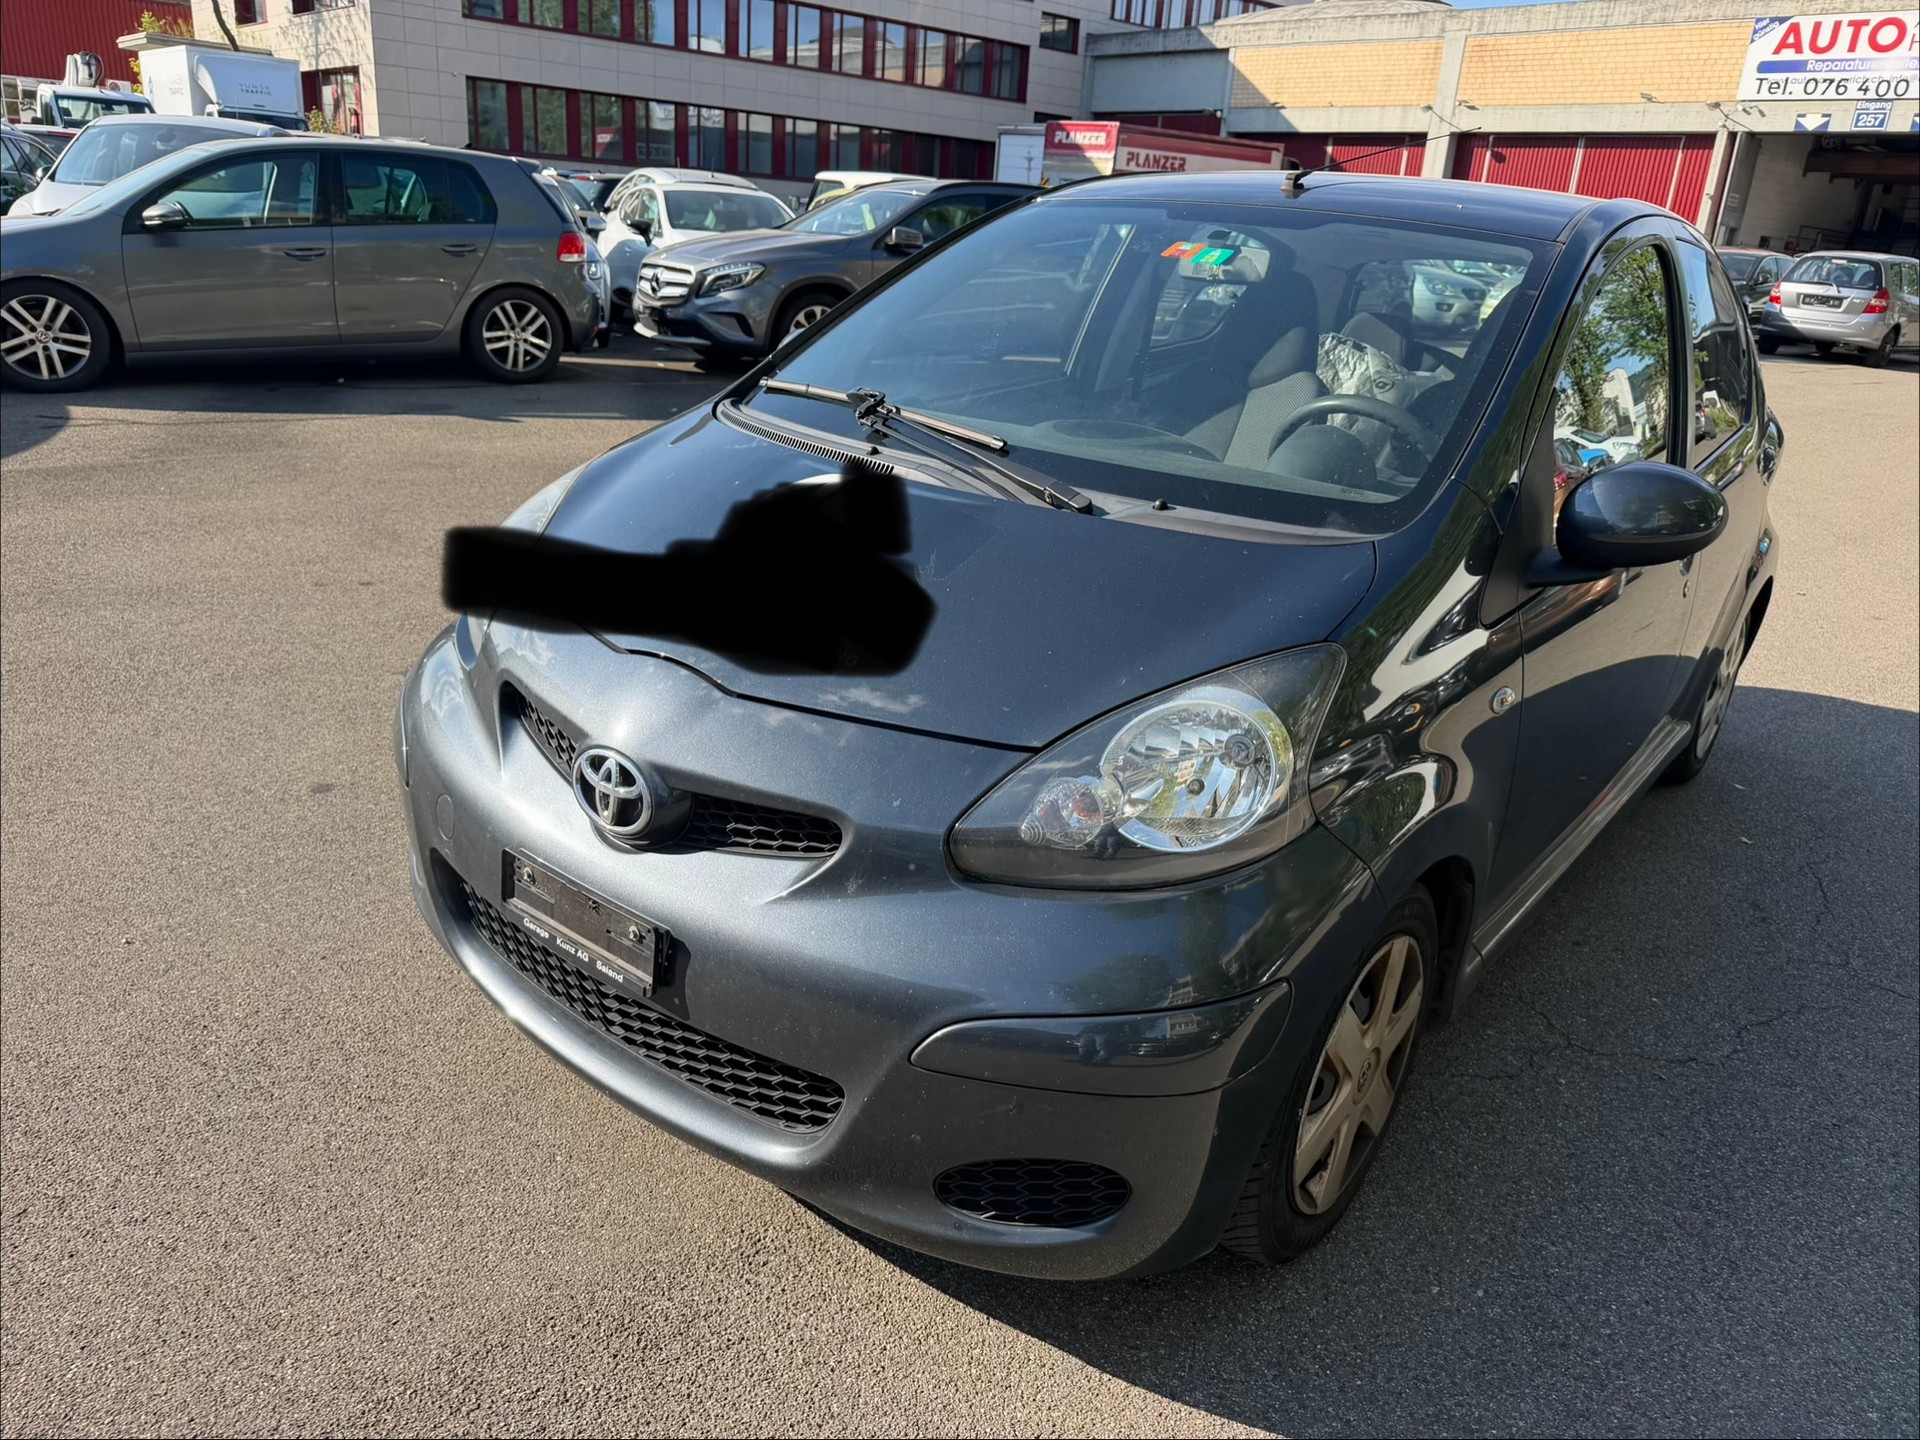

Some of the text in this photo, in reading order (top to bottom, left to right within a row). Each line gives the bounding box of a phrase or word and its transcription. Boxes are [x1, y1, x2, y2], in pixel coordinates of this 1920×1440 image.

[1771, 17, 1908, 55] AUTO
[1755, 76, 1793, 95] Tel.
[1803, 77, 1849, 96] 076
[1857, 77, 1910, 98] 400
[1856, 101, 1892, 110] Eingang
[1857, 114, 1884, 127] 257
[1054, 131, 1107, 145] PLANZER
[1126, 151, 1187, 172] PLANZER
[523, 918, 549, 939] Garage
[556, 937, 576, 955] Kunz
[576, 949, 589, 963] AG
